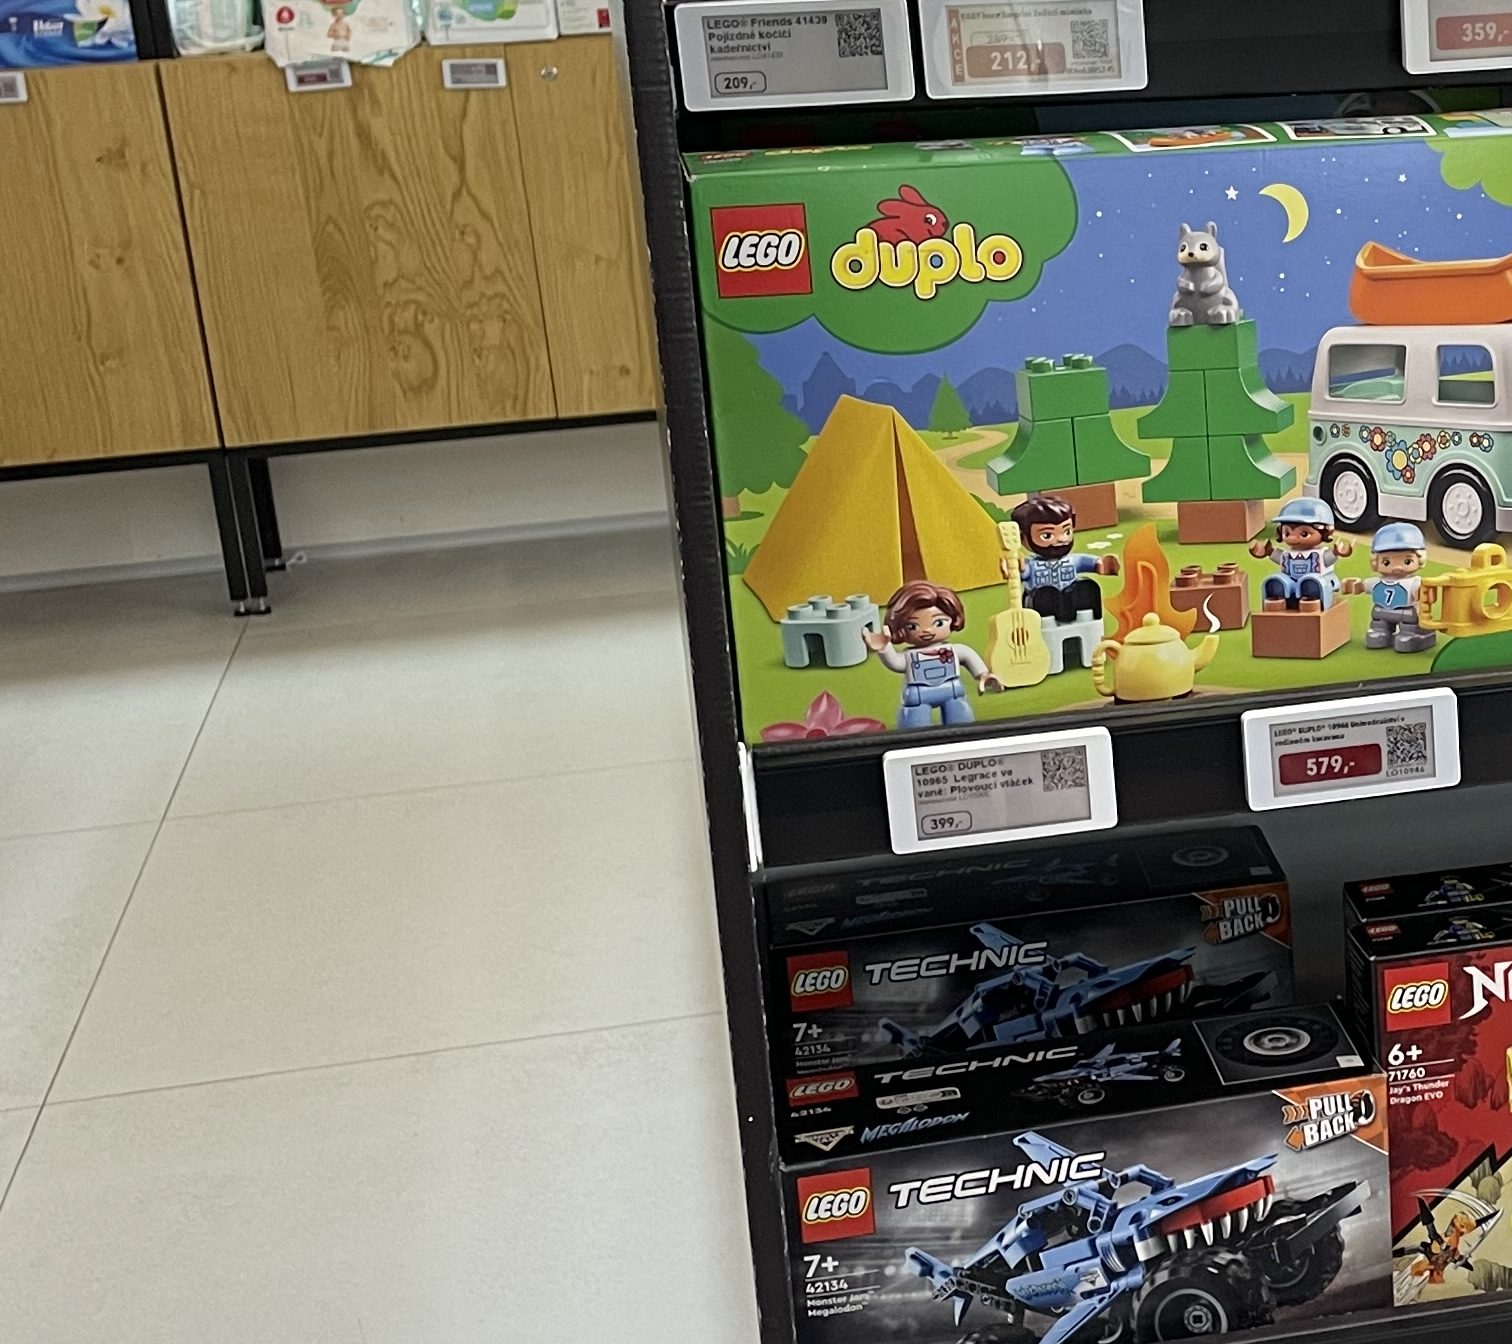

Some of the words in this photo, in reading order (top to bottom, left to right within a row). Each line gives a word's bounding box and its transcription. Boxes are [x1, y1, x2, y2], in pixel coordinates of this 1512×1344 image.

[750, 17, 793, 28] Friends
[1462, 23, 1511, 42] 359,-
[990, 51, 1040, 71] 212,-
[724, 77, 757, 90] 209,-
[720, 230, 803, 270] LEGO
[830, 222, 1024, 300] duplo
[1384, 588, 1395, 605] 7
[1306, 755, 1355, 776] 579,-
[916, 776, 948, 786] 10965
[953, 770, 998, 785] Legrace
[930, 817, 963, 830] 399,-
[1221, 896, 1264, 919] PULL
[1217, 913, 1268, 944] BACK
[865, 940, 1050, 985] TECHNIC
[793, 971, 847, 993] LEGO
[1390, 981, 1447, 1011] LEGO
[792, 1023, 824, 1042] 7+
[1388, 1044, 1422, 1065] 6+
[791, 1078, 853, 1097] LEGO
[874, 1046, 1079, 1084] TECHNIC
[1389, 1067, 1425, 1081] 71760
[1412, 1080, 1449, 1091] Thunder
[1308, 1092, 1354, 1123] PULL
[1390, 1096, 1422, 1104] Dragon
[1424, 1091, 1443, 1101] EVO
[860, 1111, 971, 1144] MEGALODON
[1303, 1113, 1358, 1150] BACK
[803, 1185, 870, 1223] LEGO
[888, 1151, 1106, 1209] TECHNIC
[803, 1254, 839, 1277] 7+
[805, 1279, 848, 1293] 42134
[807, 1294, 847, 1307] Monster
